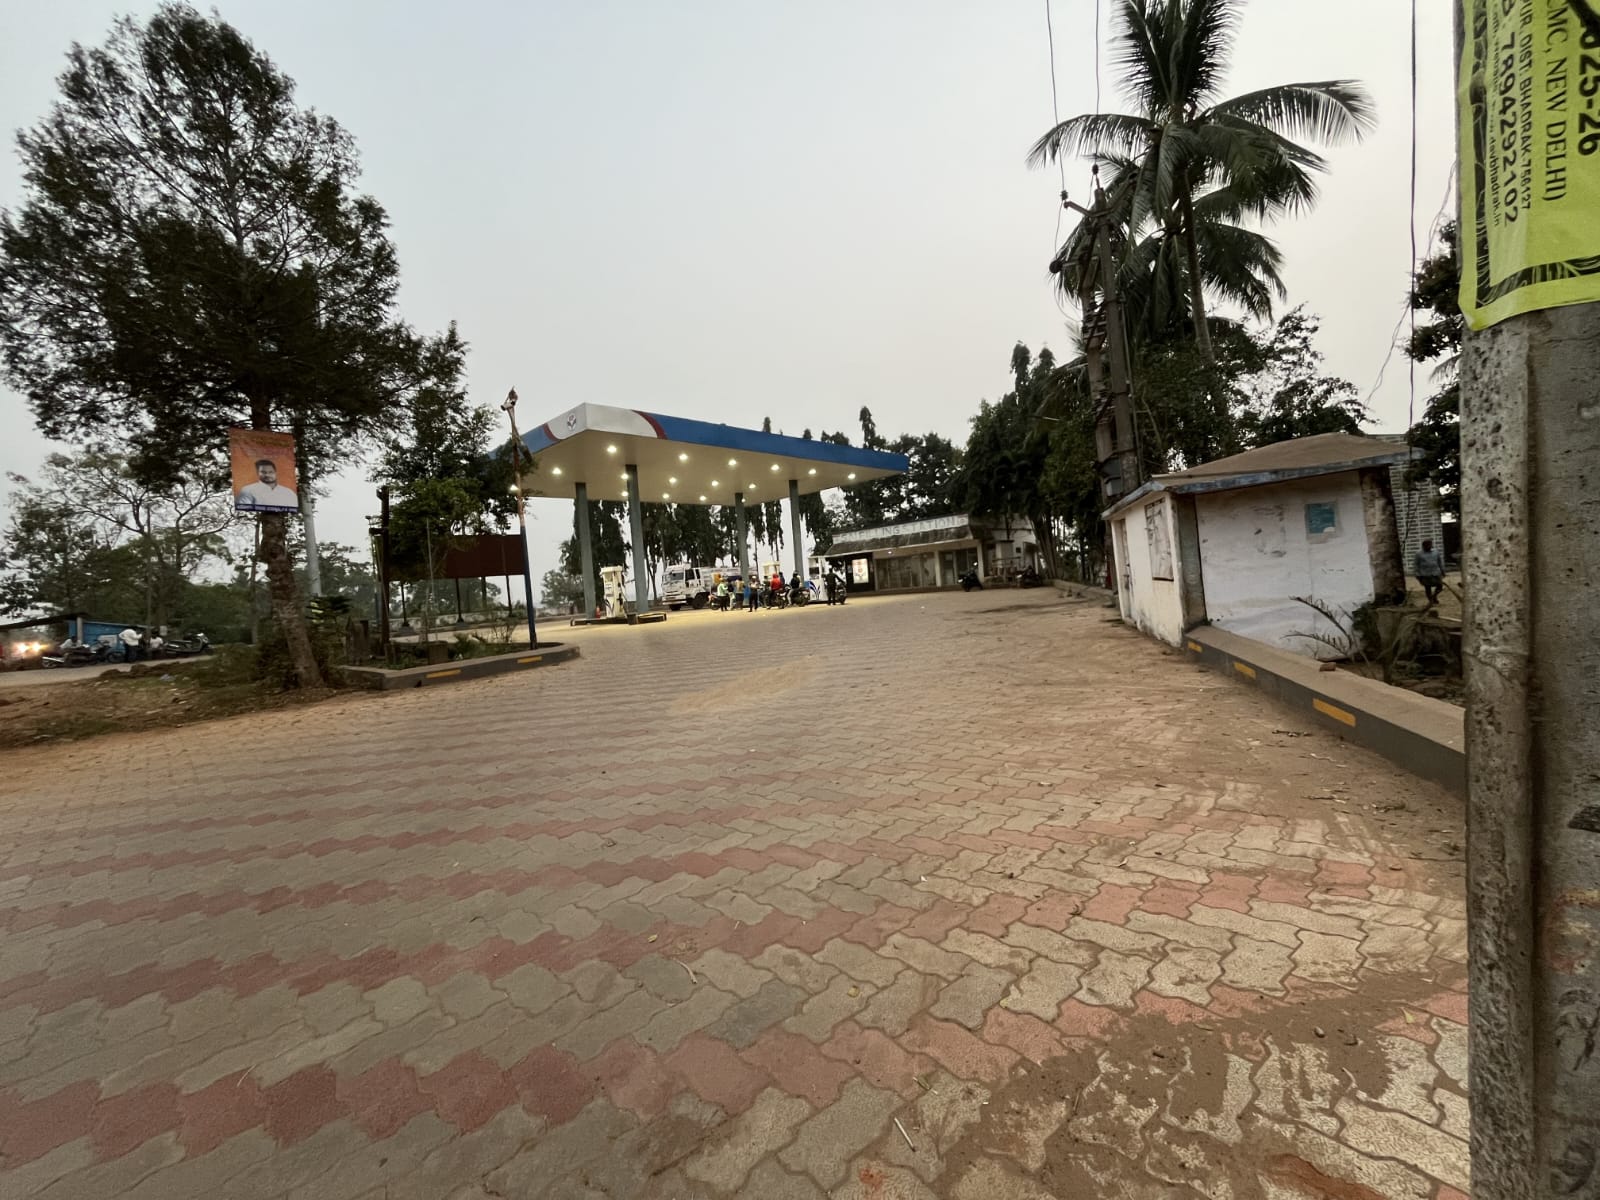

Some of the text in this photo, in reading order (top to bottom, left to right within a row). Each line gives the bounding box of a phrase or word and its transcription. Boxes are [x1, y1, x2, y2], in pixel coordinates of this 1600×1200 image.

[1546, 57, 1567, 112] NEW
[1578, 10, 1600, 155] 025-26
[1542, 121, 1567, 201] DELHI)
[903, 517, 956, 532] STATION
